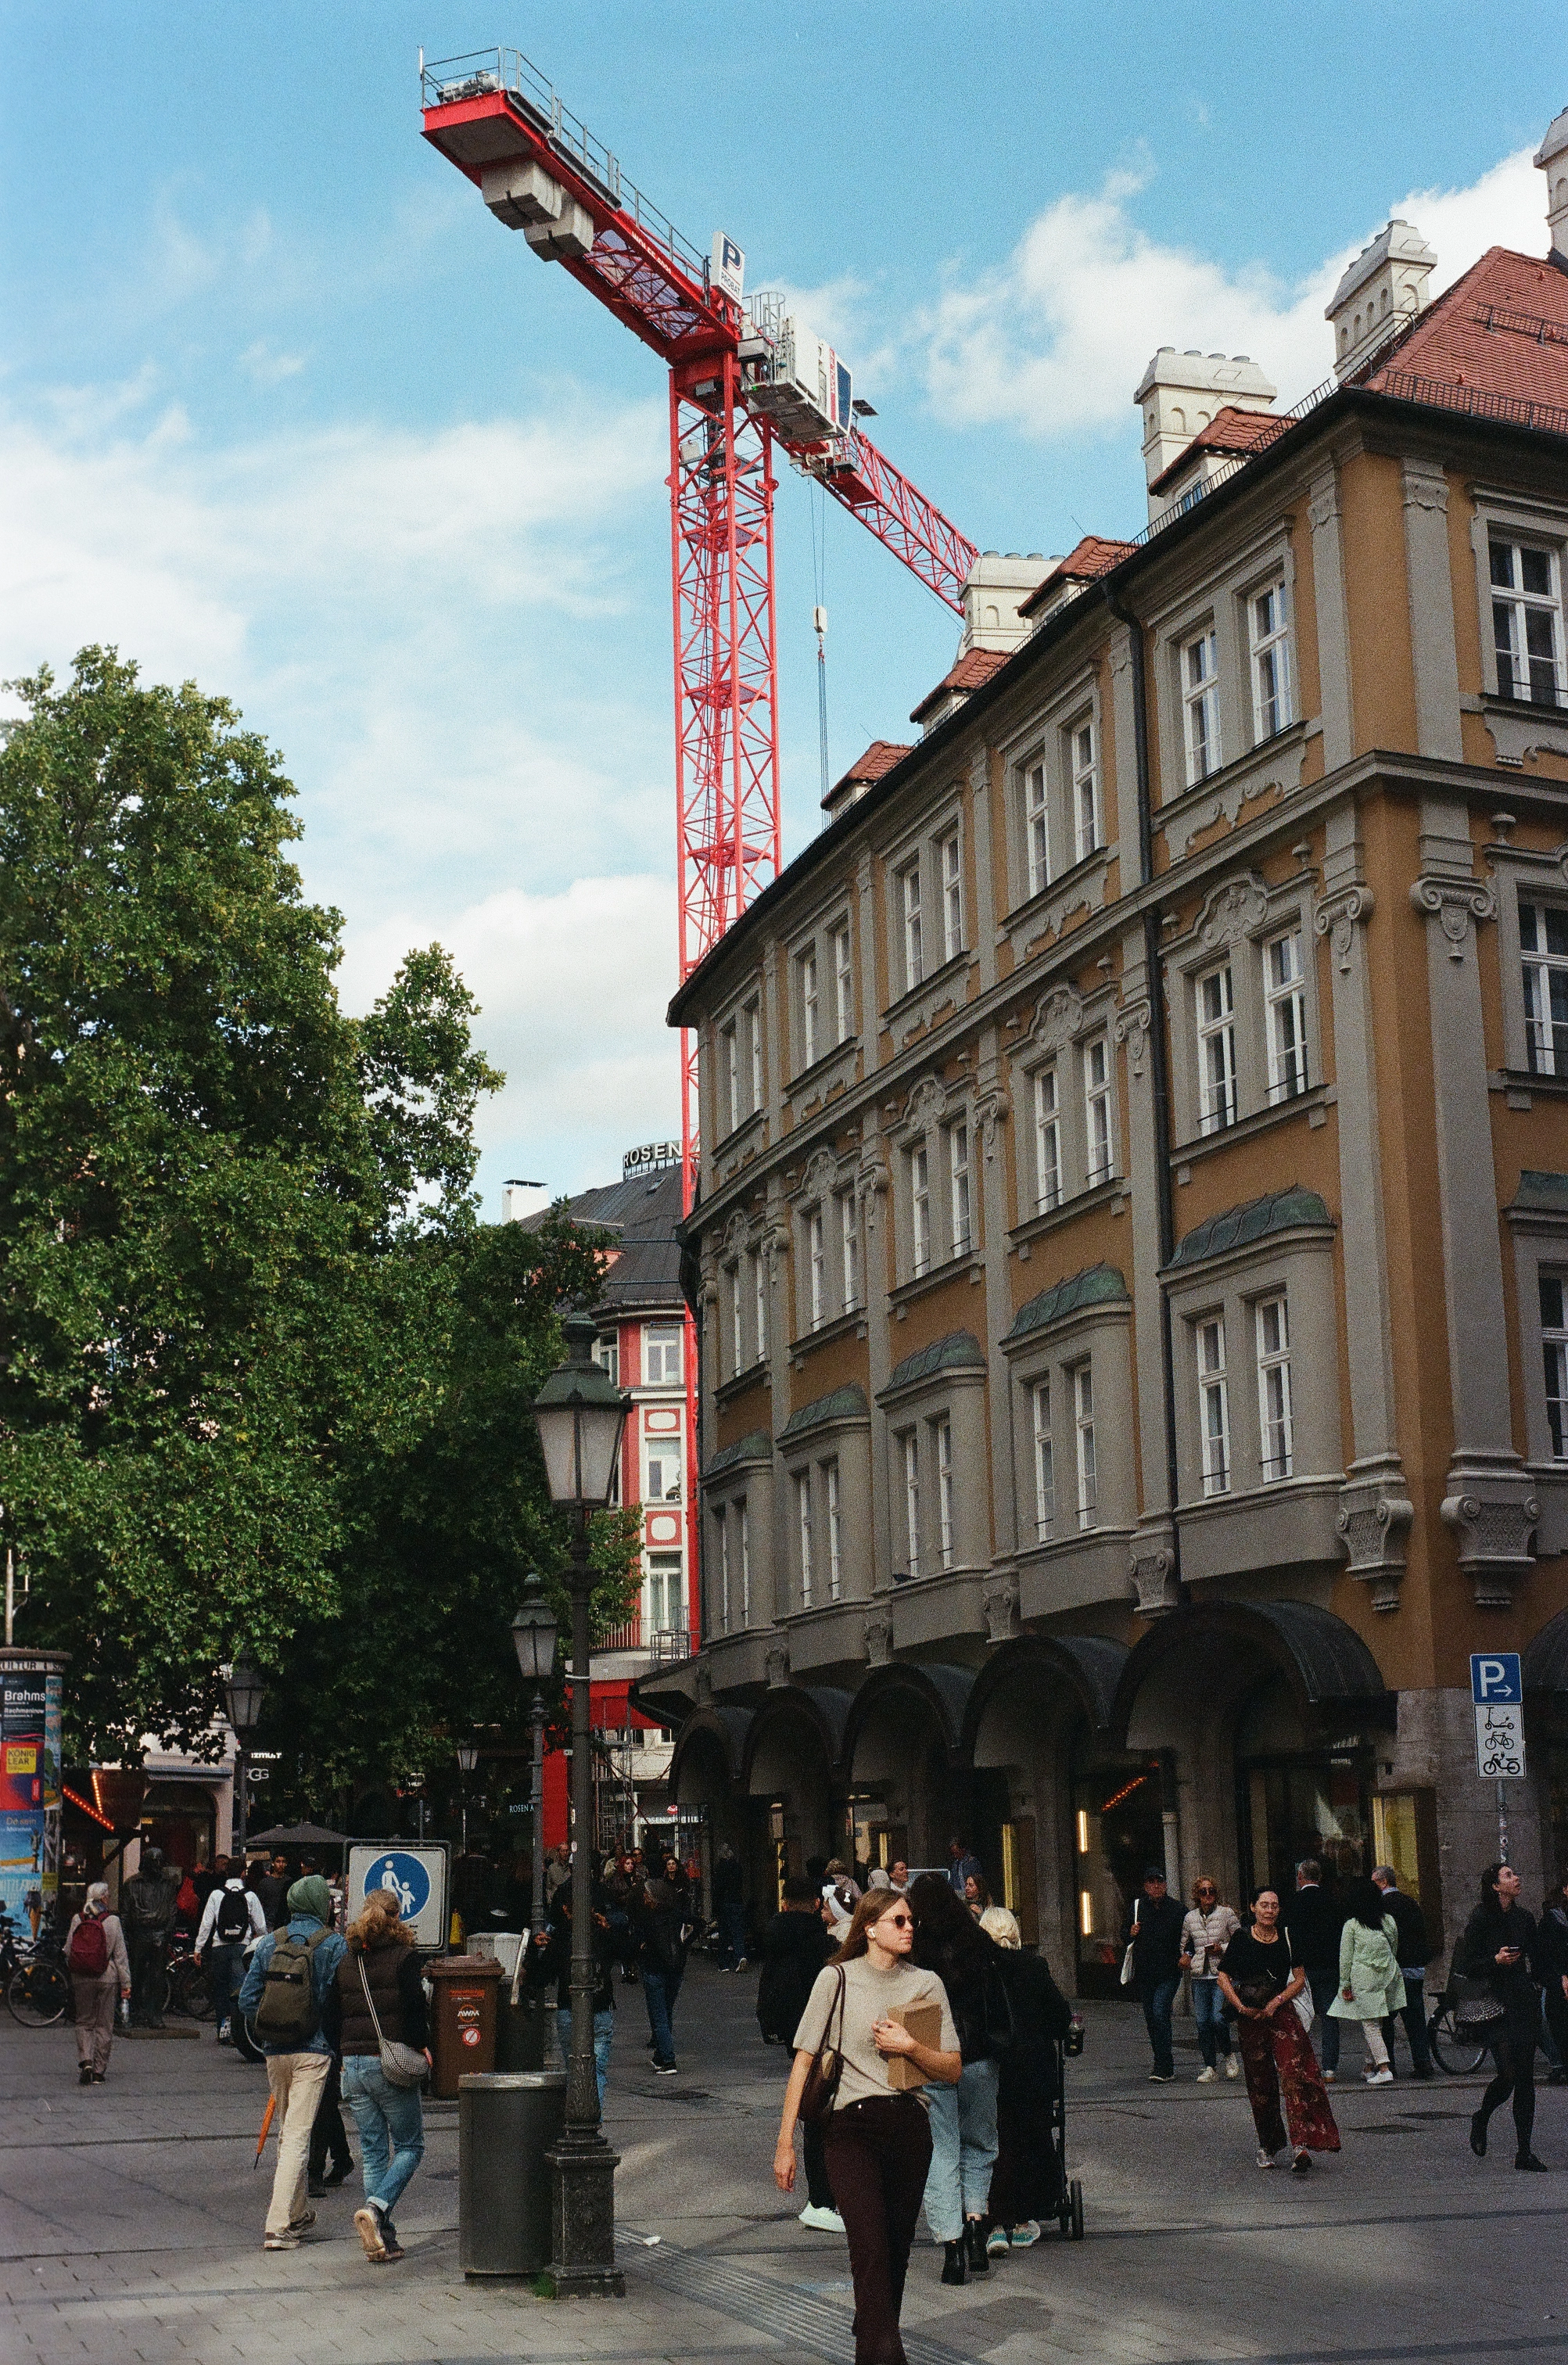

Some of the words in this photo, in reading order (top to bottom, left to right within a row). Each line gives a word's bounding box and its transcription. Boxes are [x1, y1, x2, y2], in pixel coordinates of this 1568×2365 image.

[720, 271, 741, 295] PROBAT
[623, 1141, 683, 1168] ROSEN
[1479, 1660, 1505, 1697] P
[4, 1689, 46, 1702] Brahms
[8, 1749, 35, 1757] KÖNIG
[509, 1803, 529, 1814] ROSEN
